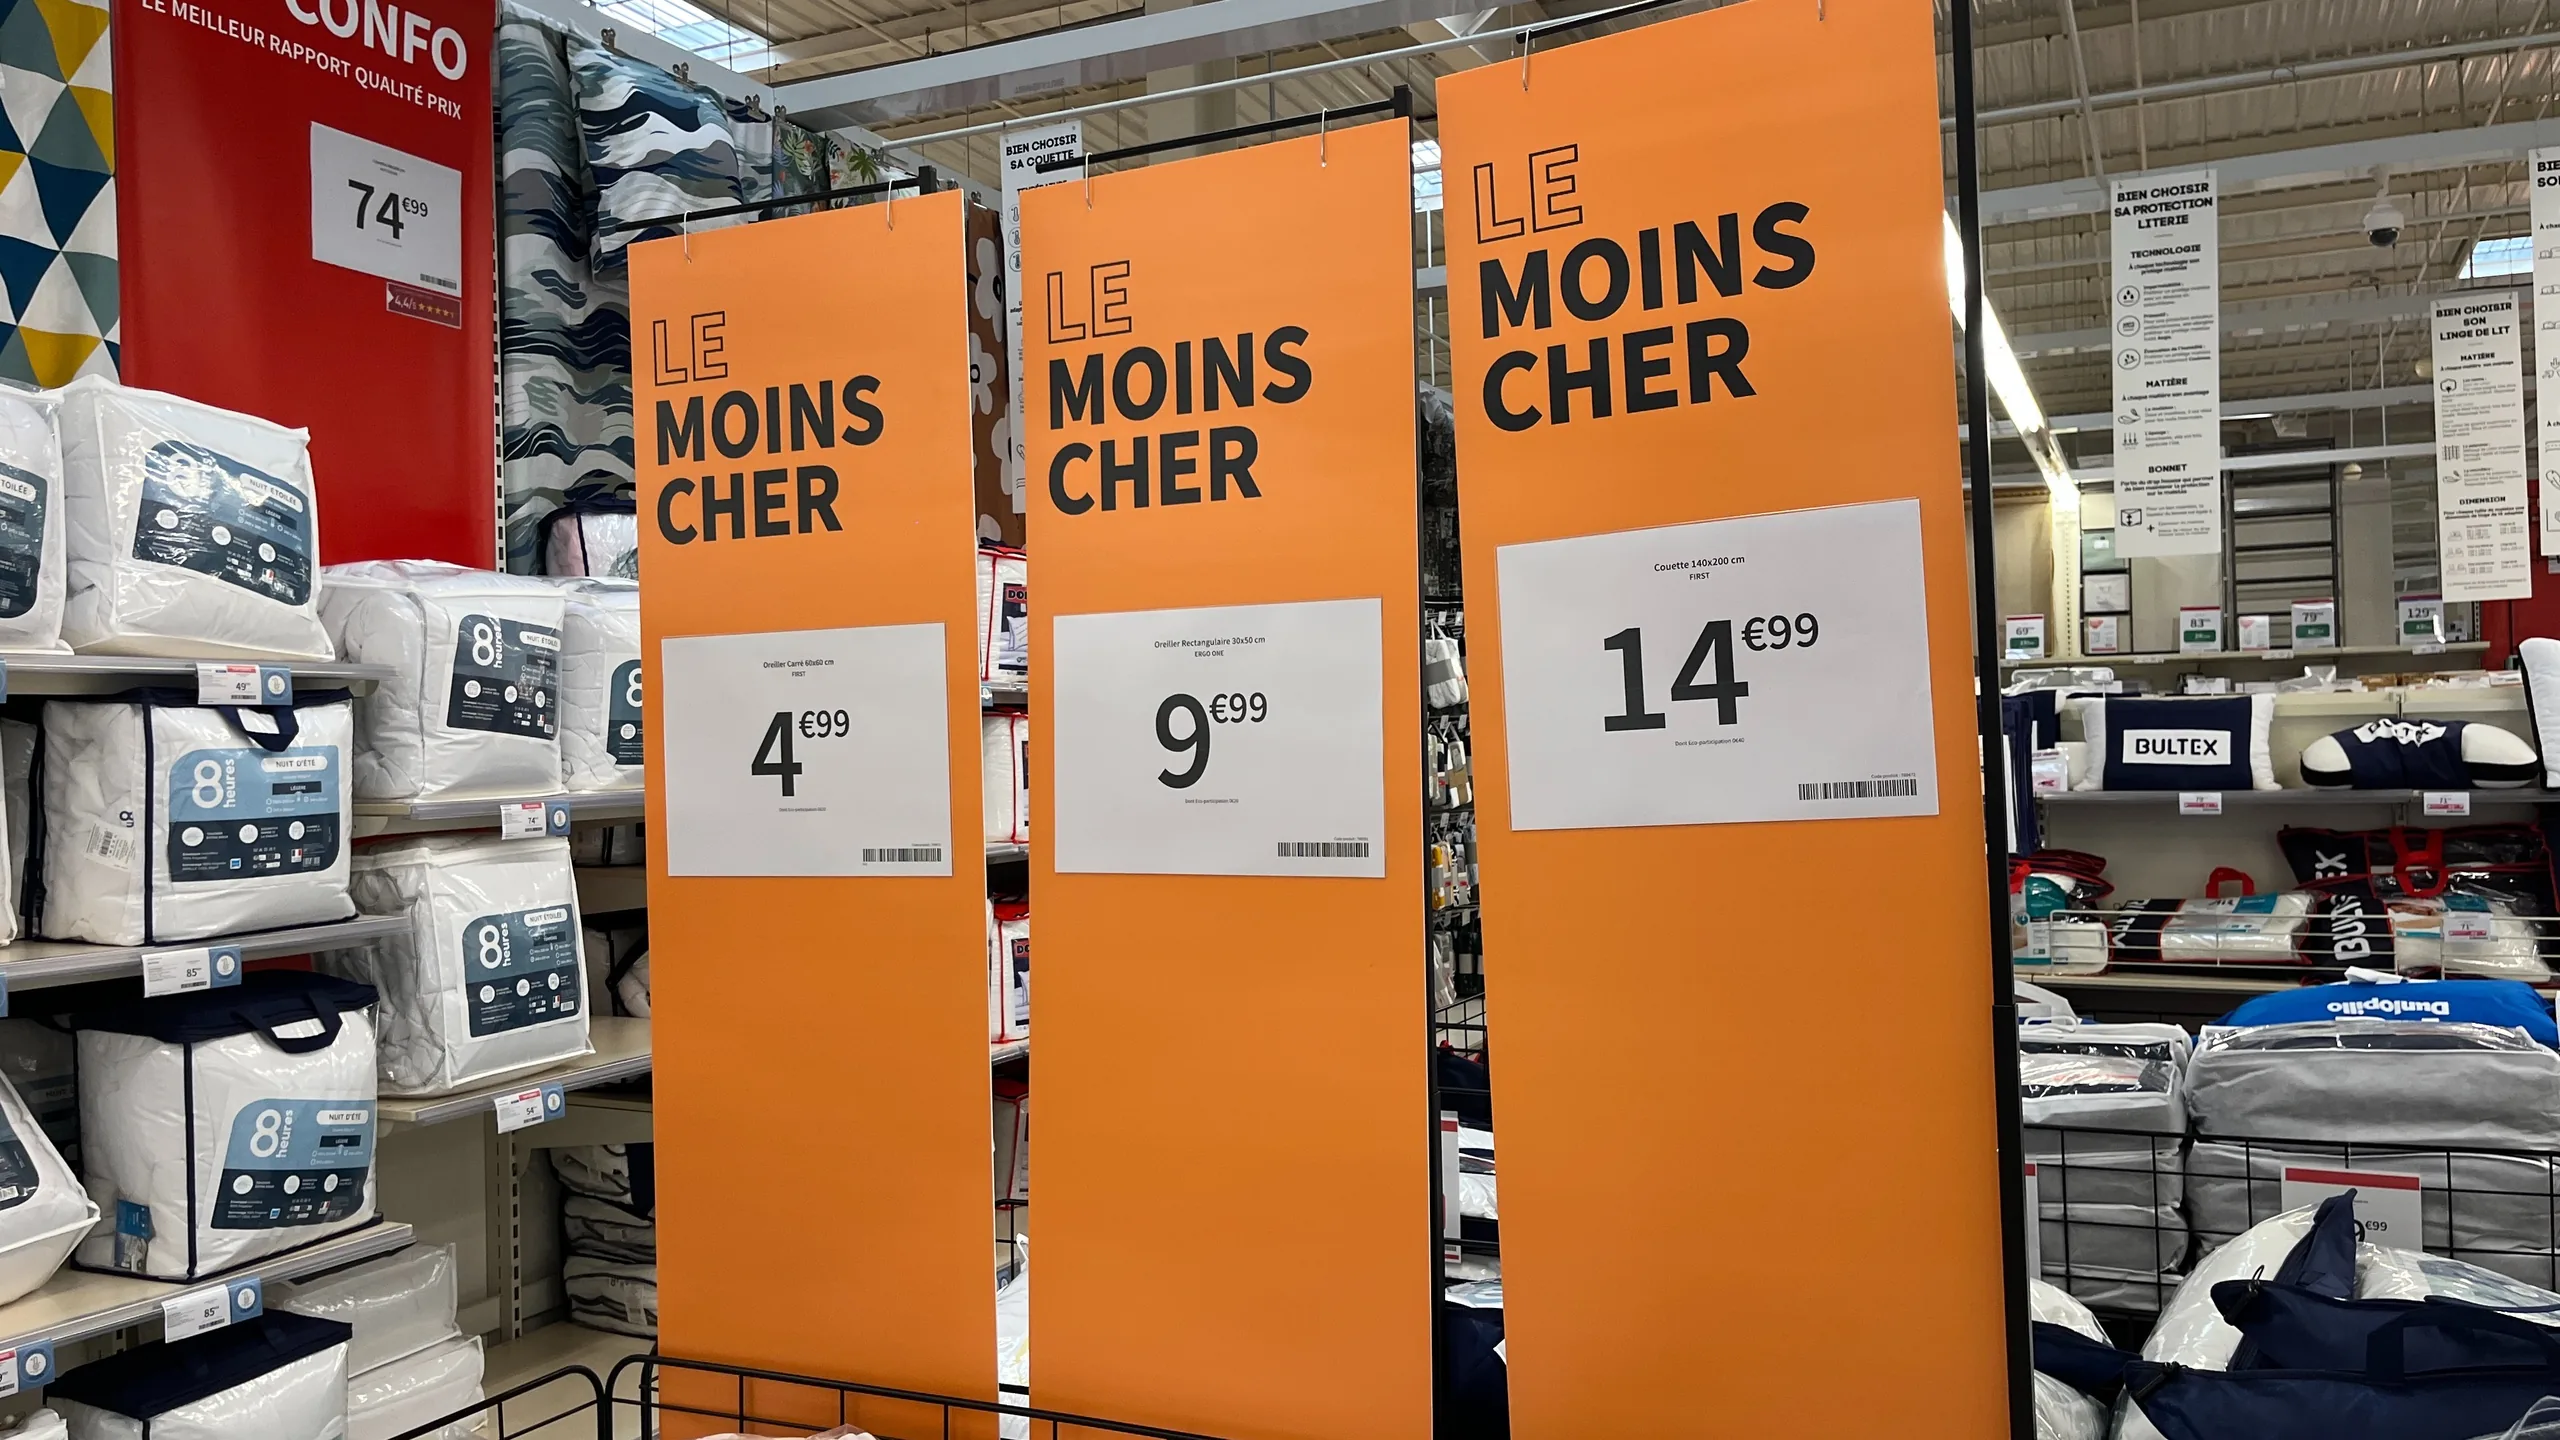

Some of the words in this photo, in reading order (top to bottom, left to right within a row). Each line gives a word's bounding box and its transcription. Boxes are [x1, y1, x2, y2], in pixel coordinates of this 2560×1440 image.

[172, 0, 265, 48] MEILLEUR
[270, 35, 350, 78] RAPPORT
[355, 66, 424, 105] QUALITÉ
[427, 94, 462, 120] PRIX
[1006, 143, 1029, 156] BIEN
[1032, 134, 1077, 151] CHOISIR
[1010, 159, 1024, 170] SA
[1027, 149, 1074, 167] COUETTE
[2537, 175, 2560, 188] SO
[1473, 143, 1583, 244] LE
[2117, 190, 2147, 202] BIEN
[2151, 182, 2209, 198] CHOISIR
[2114, 206, 2131, 217] SA
[2133, 197, 2213, 215] PROTECTION
[2138, 214, 2189, 229] LITERIE
[2130, 244, 2202, 259] TECHNOLOGIE
[1479, 201, 1816, 339] MOINS
[1046, 260, 1132, 344] LE
[2436, 307, 2461, 318] BIEN
[2464, 302, 2512, 315] CHOISIR
[2463, 317, 2486, 326] SON
[2440, 330, 2473, 341] LINGE
[2475, 328, 2489, 337] DE
[2492, 325, 2510, 335] LIT
[653, 311, 728, 386] LE
[1049, 325, 1312, 429] MOINS
[1482, 317, 1757, 432] CHER
[2146, 377, 2187, 388] MATIÈRE
[656, 375, 884, 465] MOINS
[1049, 425, 1262, 515] CHER
[2148, 463, 2187, 473] BONNET
[657, 465, 843, 545] CHER
[1654, 561, 1689, 572] Couette
[1691, 557, 1729, 568] 140x200
[1731, 556, 1745, 564] cm
[1689, 572, 1710, 580] FIRST
[472, 623, 494, 666] 8
[1154, 639, 1180, 648] Oreiller
[1181, 637, 1231, 648] Rectangulaire
[1231, 636, 1253, 645] 30x50
[2136, 738, 2217, 756] BULTEX
[297, 760, 316, 768] D'ÉTÉ
[192, 759, 224, 809] 8
[223, 758, 236, 809] heures
[479, 925, 502, 969] 8
[501, 922, 511, 967] heures
[2327, 997, 2450, 1016] Dunlopillo
[250, 1109, 281, 1158] 8
[276, 1109, 293, 1158] heures
